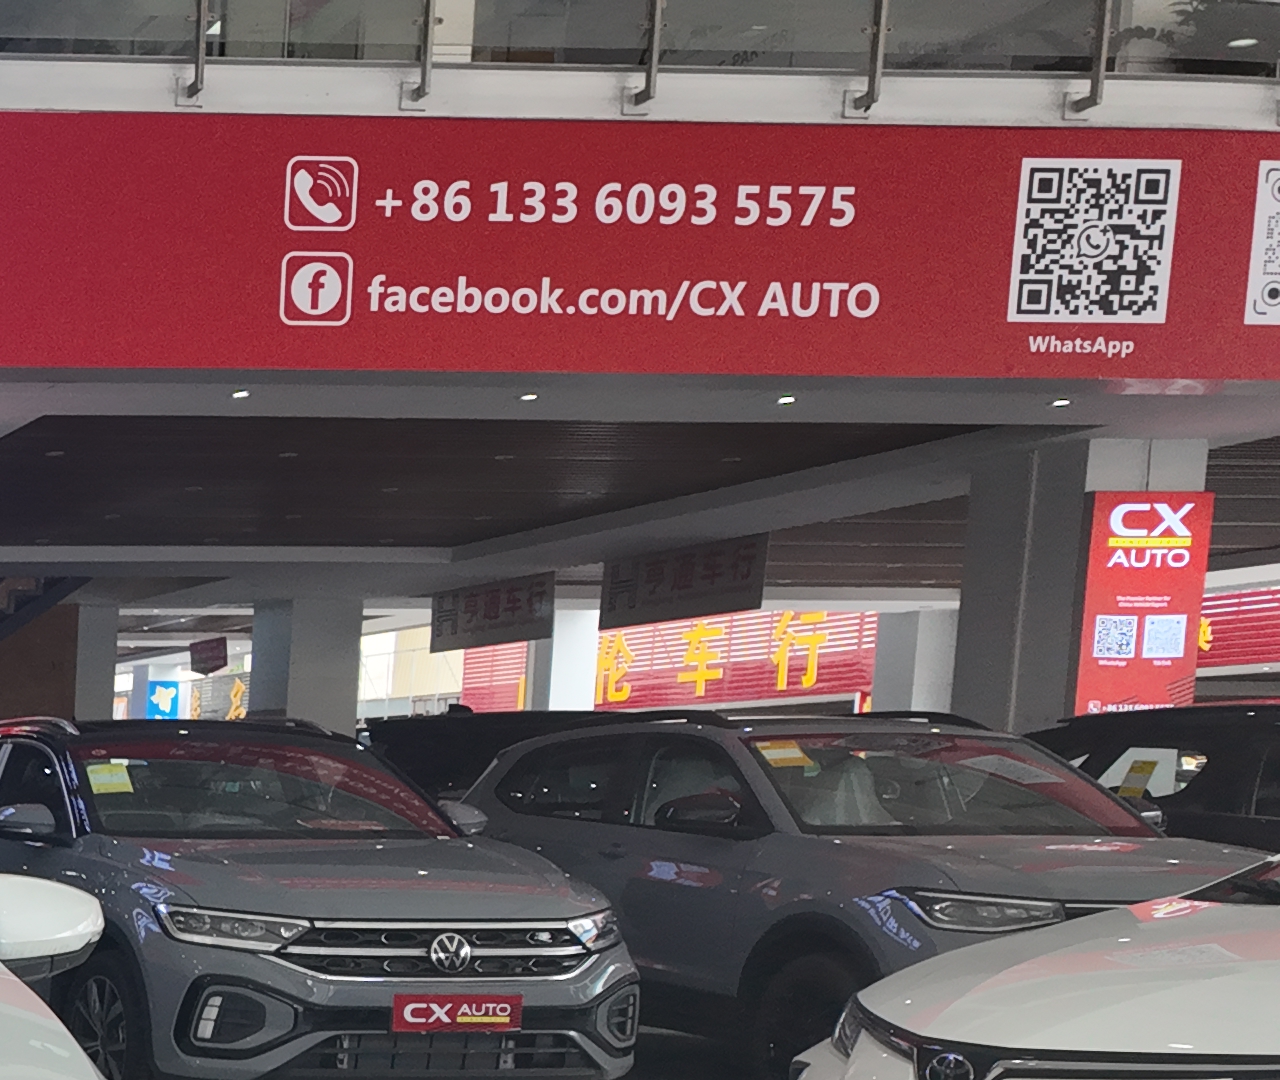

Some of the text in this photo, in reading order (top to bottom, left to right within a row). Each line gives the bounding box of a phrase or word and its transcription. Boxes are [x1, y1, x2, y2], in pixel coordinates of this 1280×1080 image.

[375, 179, 856, 228] +86 133 6093 5575
[367, 274, 880, 321] facebook.com/CX AUTO
[1028, 335, 1135, 359] WhatsApp
[1109, 503, 1196, 537] CX
[1106, 549, 1190, 568] AUTO
[403, 1002, 511, 1023] CX AUTO
